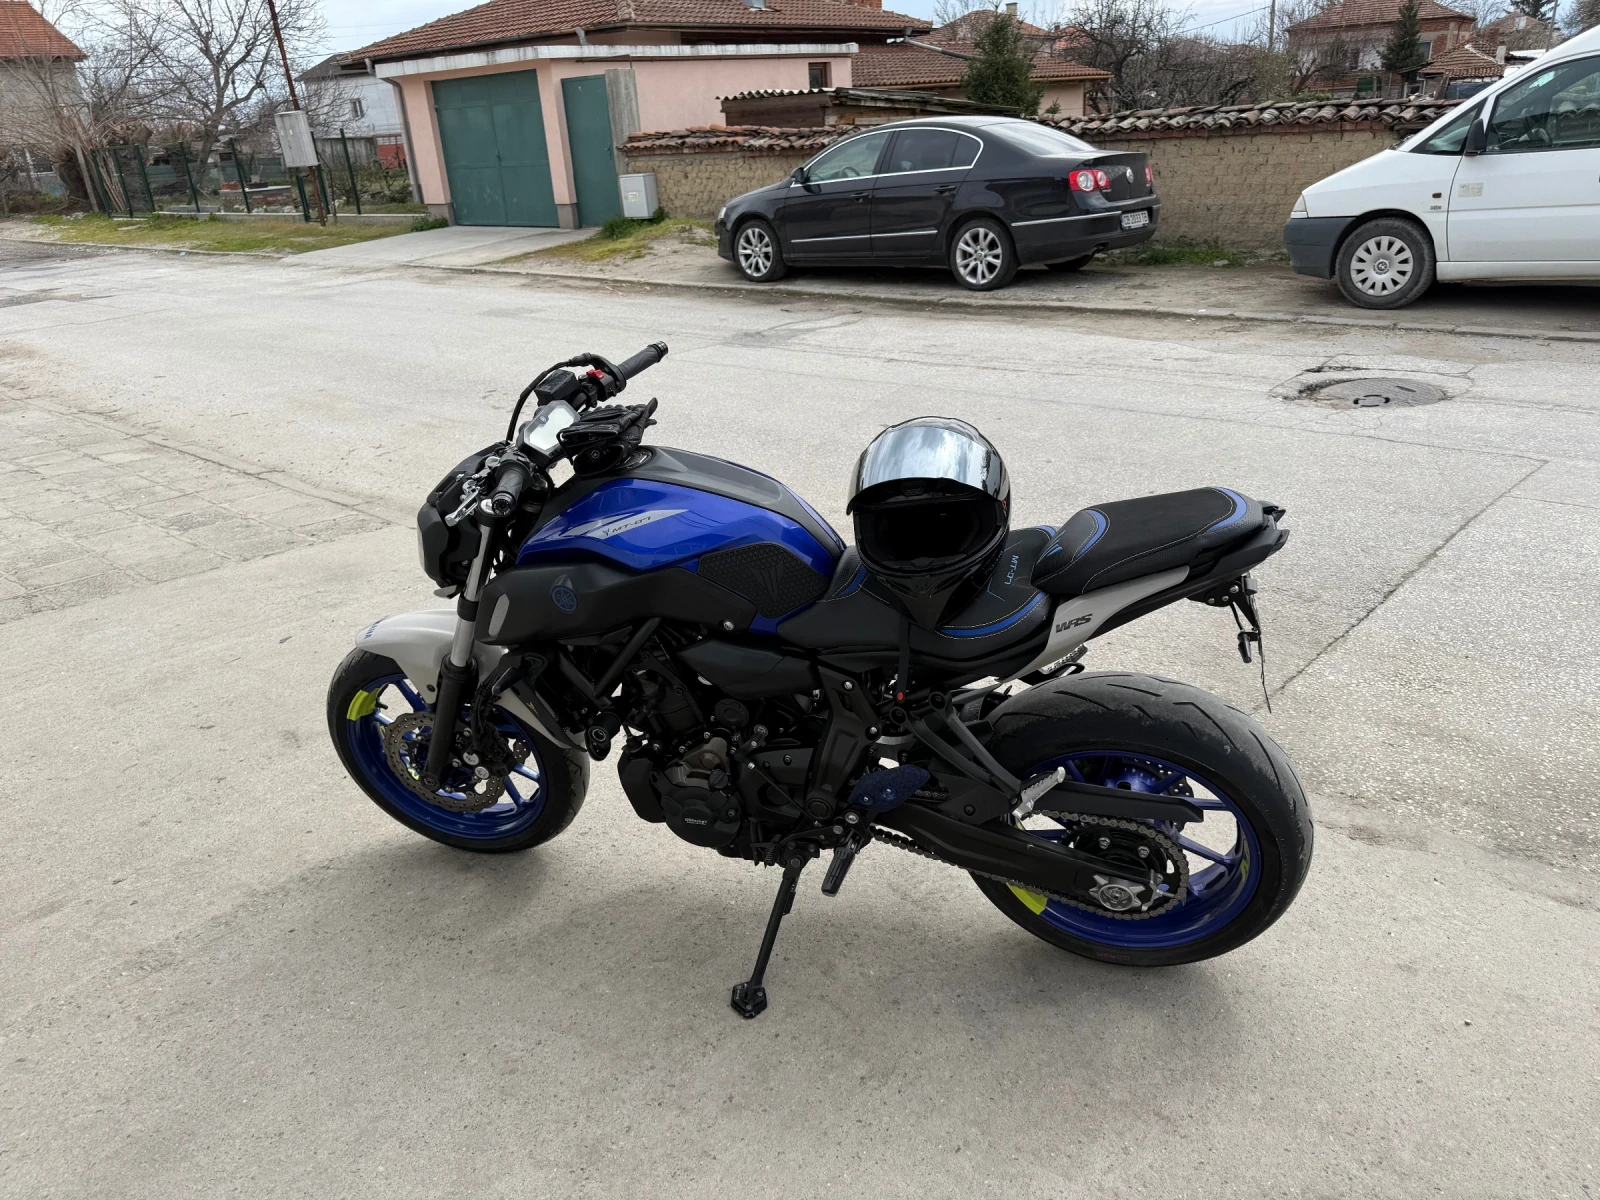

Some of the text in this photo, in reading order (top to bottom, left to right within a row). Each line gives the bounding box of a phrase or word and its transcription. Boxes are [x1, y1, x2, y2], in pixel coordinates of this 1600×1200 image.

[612, 516, 652, 534] MT-07
[1004, 554, 1019, 585] MT-07
[1056, 613, 1093, 634] WRS
